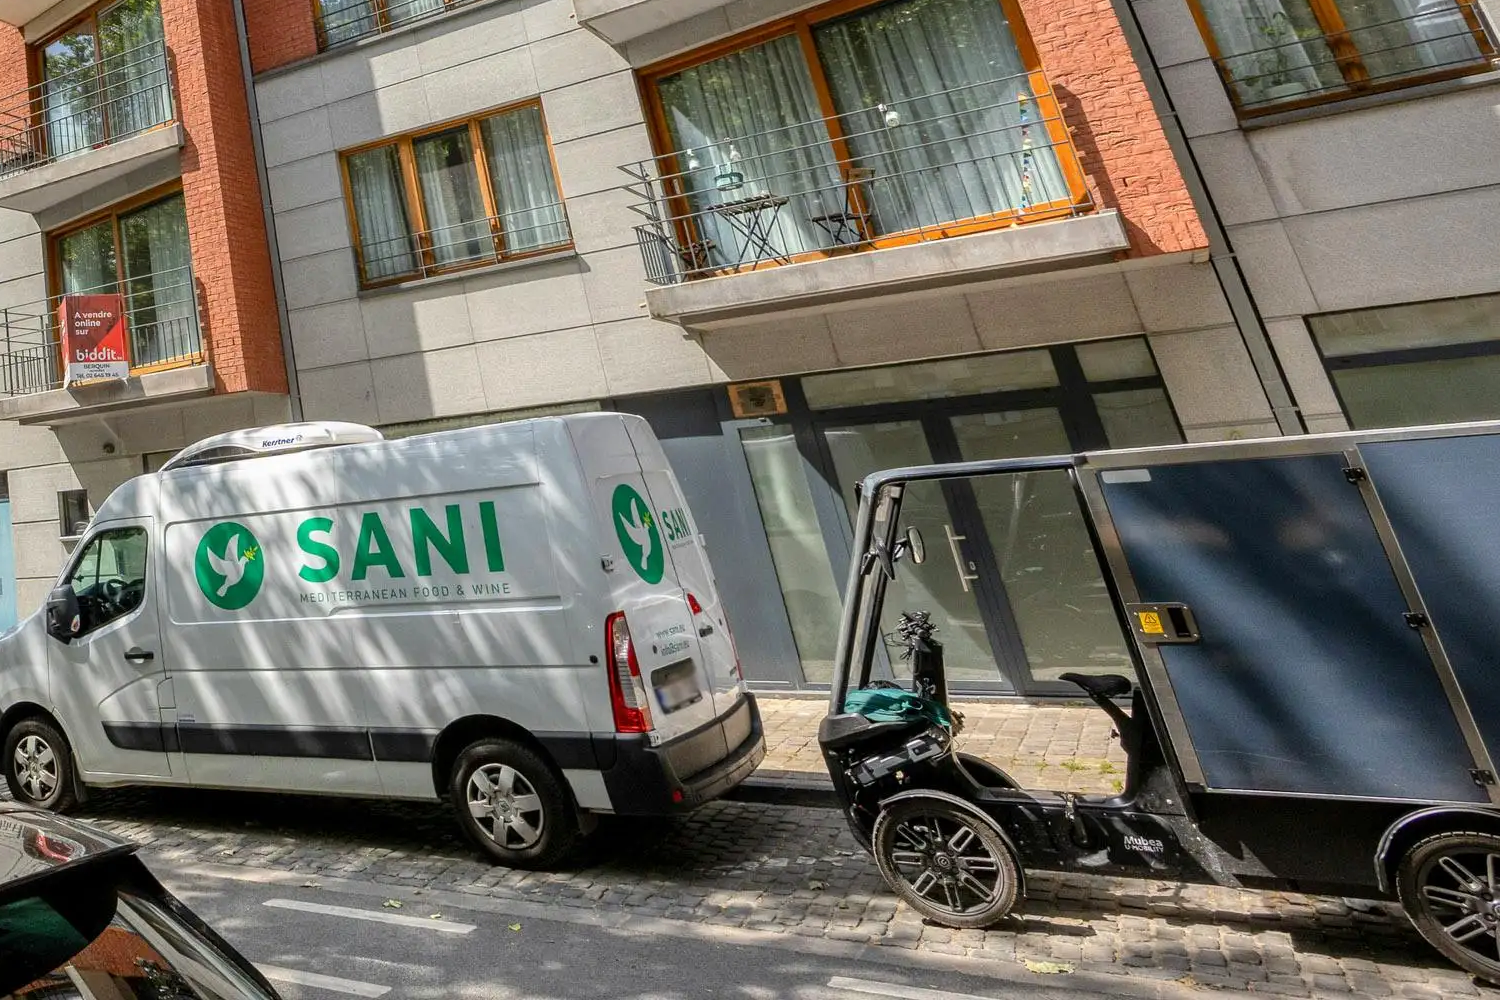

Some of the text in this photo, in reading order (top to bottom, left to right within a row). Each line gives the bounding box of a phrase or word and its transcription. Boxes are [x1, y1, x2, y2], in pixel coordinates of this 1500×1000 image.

[82, 311, 112, 319] vendre
[262, 438, 294, 447] Kerstner
[661, 507, 692, 541] SANI
[297, 501, 505, 583] SANI
[300, 583, 511, 603] MEDITERRANEAN FOOD & WINE
[1124, 836, 1163, 847] Mubea
